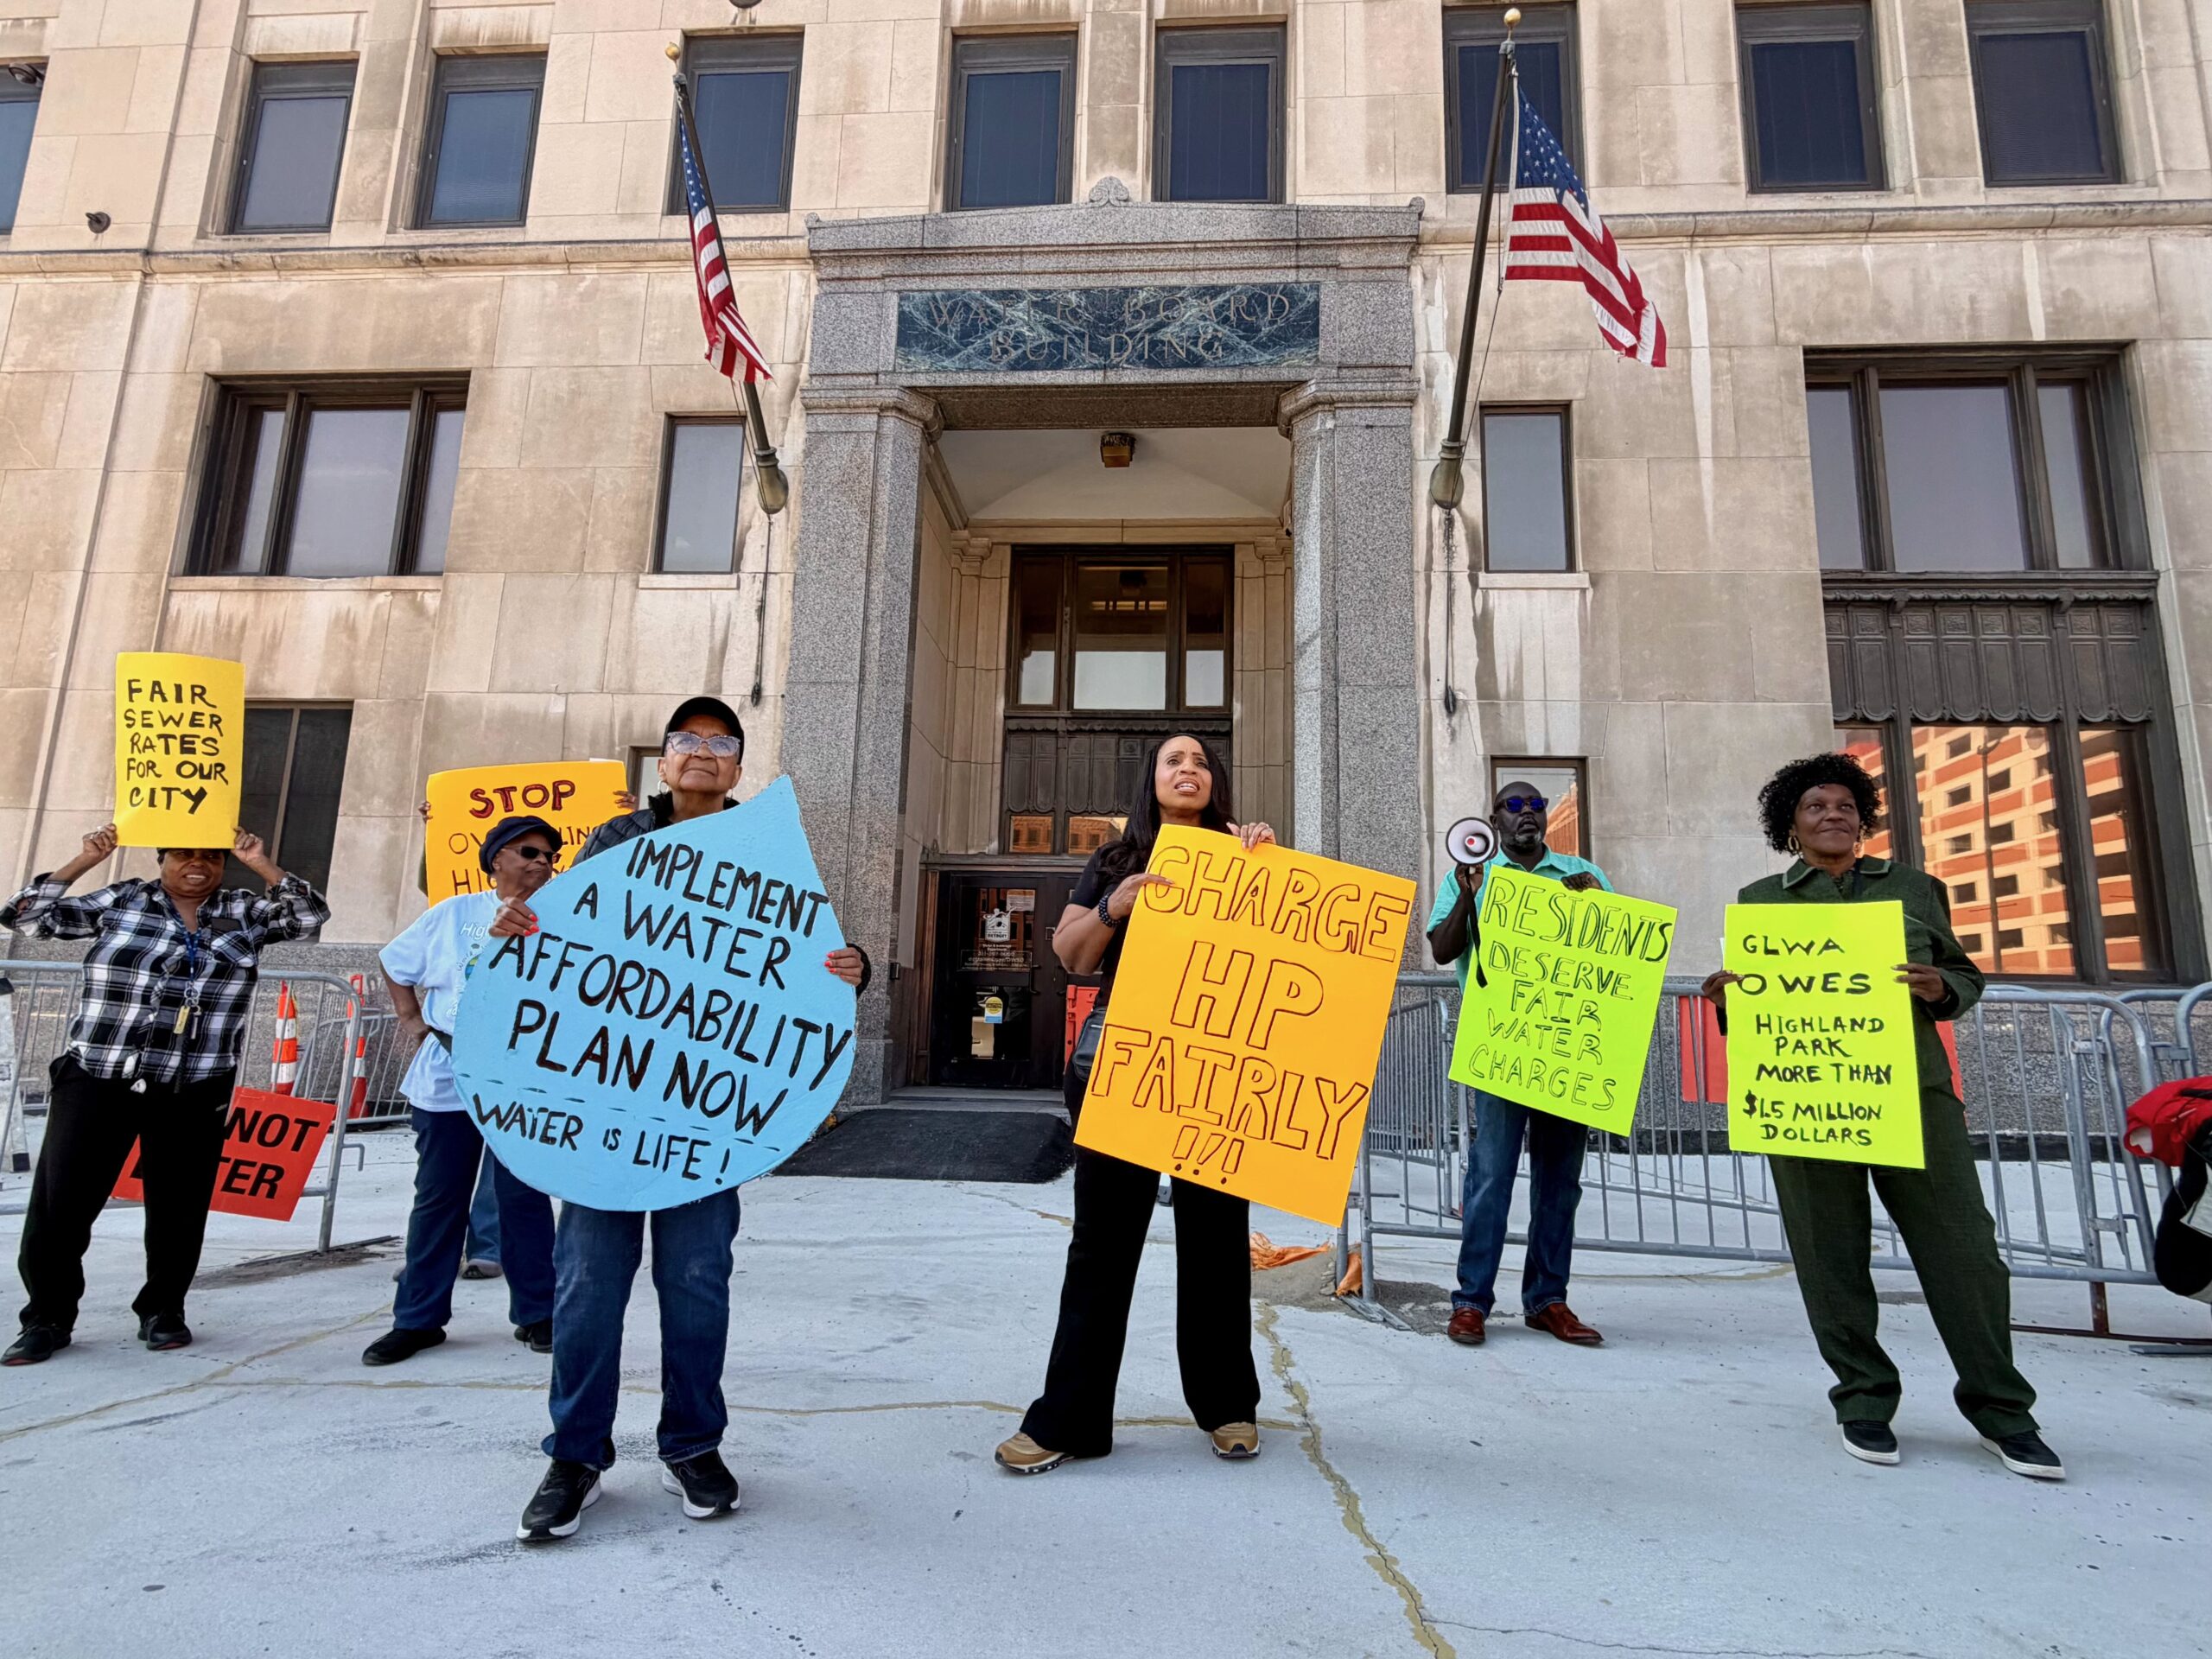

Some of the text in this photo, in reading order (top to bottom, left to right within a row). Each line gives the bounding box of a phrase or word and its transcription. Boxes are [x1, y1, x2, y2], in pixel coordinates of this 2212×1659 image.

[929, 294, 1289, 327] WATER BOARD
[990, 331, 1223, 362] BUILDING
[128, 679, 217, 708] FAIR
[124, 709, 223, 736] SEWER
[130, 732, 219, 756] RATES
[127, 758, 228, 785] FOR OUR
[130, 786, 207, 815] CITY
[469, 780, 575, 819] STOP
[626, 837, 829, 938] IMPLEMENT
[1143, 845, 1410, 962] CHARGE
[574, 882, 598, 919] A
[625, 890, 791, 990] WATER
[1484, 876, 1673, 963] RESIDENTS
[1742, 934, 1845, 956] GLWA
[1488, 940, 1633, 1000] DESERVE
[1738, 972, 1872, 995] OWES
[489, 933, 853, 1091] AFFORDABILITY
[1171, 940, 1324, 1050] HP
[1511, 980, 1601, 1032] FAIR
[1488, 1008, 1602, 1065] WATER
[1756, 1014, 1885, 1035] HIGHLAND
[1775, 1036, 1853, 1058] PARK
[507, 1000, 788, 1136] PLAN NOW
[1469, 1044, 1617, 1111] CHARGES
[1755, 1063, 1892, 1085] MORE THAN
[1090, 1024, 1369, 1160] FAIRLY
[224, 1107, 320, 1153] NOT
[473, 1093, 583, 1151] WATER
[602, 1128, 621, 1151] IS
[1792, 1102, 1882, 1122] MILLION
[1760, 1124, 1872, 1147] DOLLARS
